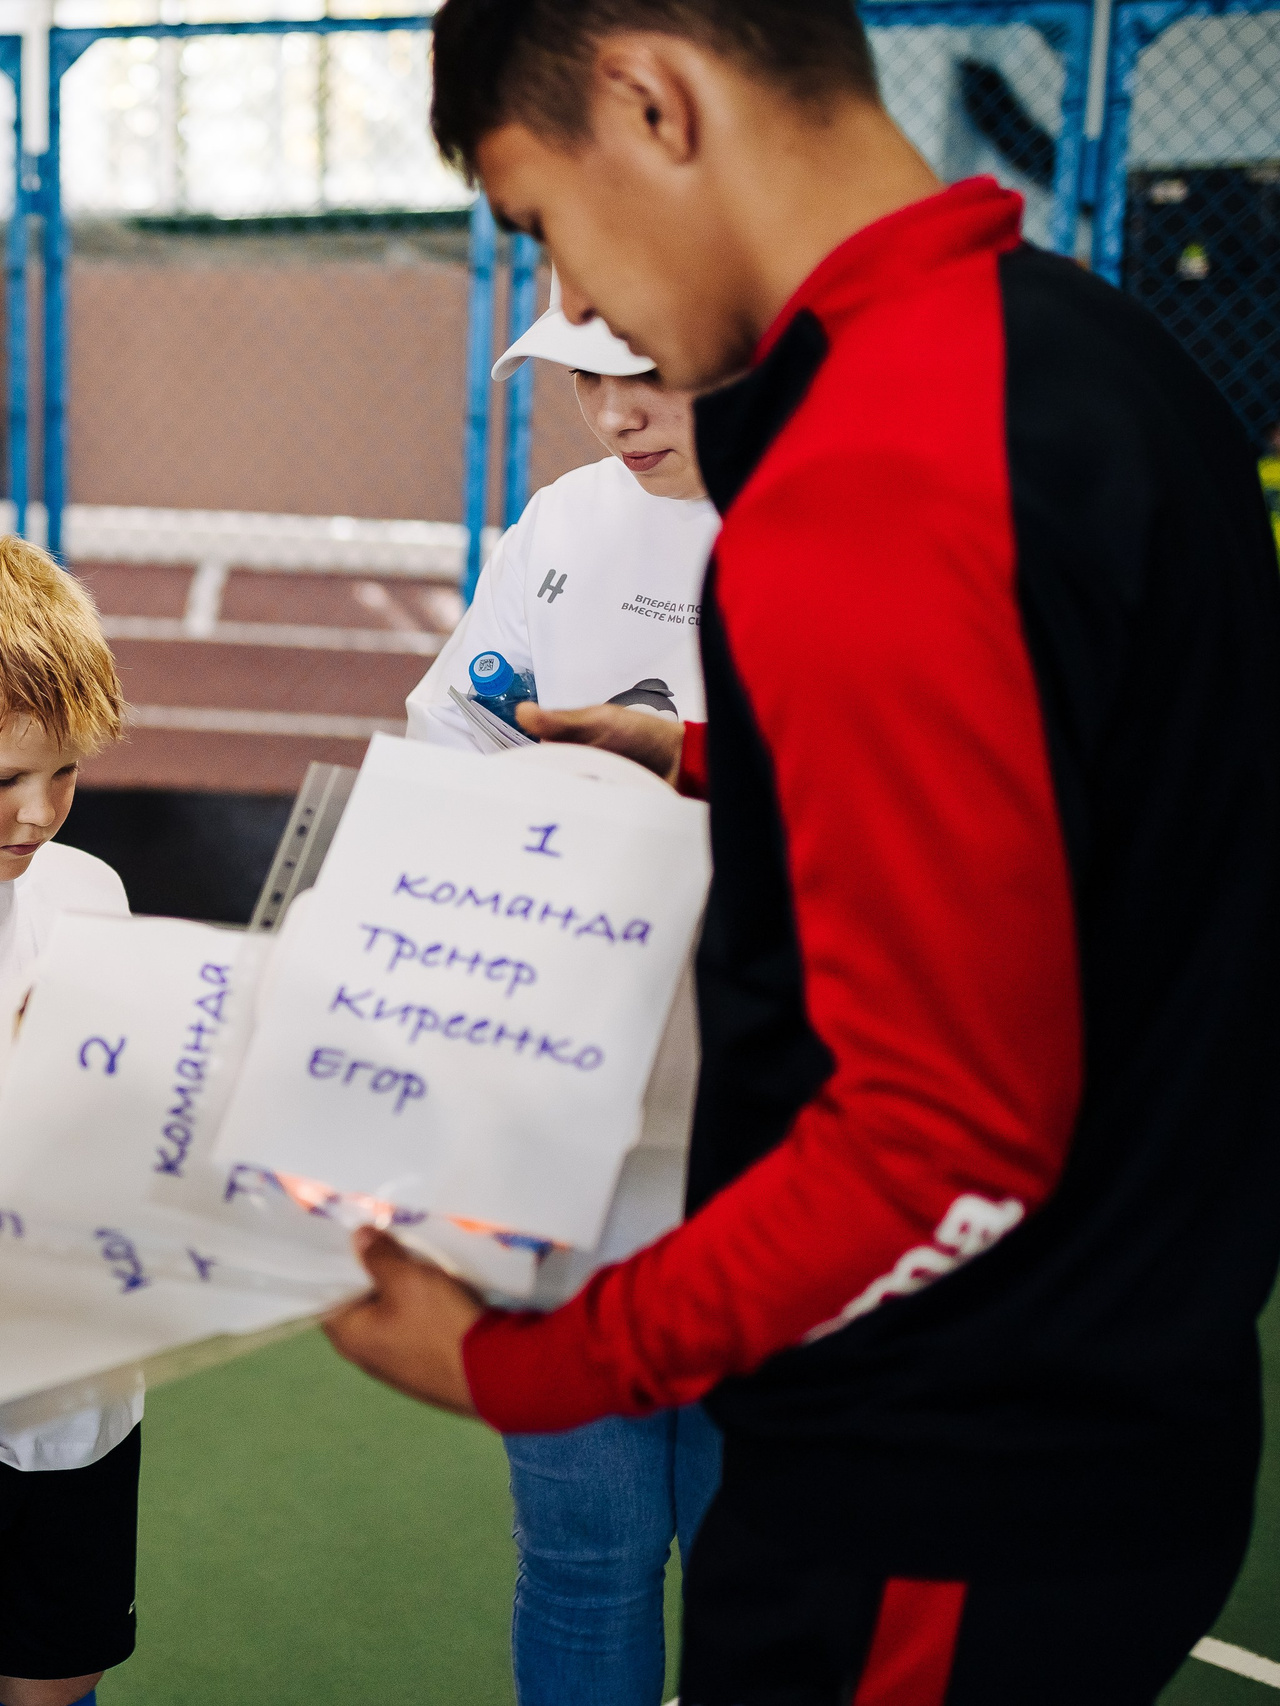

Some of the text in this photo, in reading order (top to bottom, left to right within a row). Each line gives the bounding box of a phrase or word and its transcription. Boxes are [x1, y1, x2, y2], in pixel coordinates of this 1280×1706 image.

[621, 602, 666, 621] ВМЕСТЕ
[667, 614, 685, 624] МЫ
[634, 594, 677, 612] ВПЕРЁД
[678, 603, 685, 612] К
[523, 823, 561, 858] 1
[79, 1035, 126, 1076] 2
[308, 1047, 426, 1114] Егор
